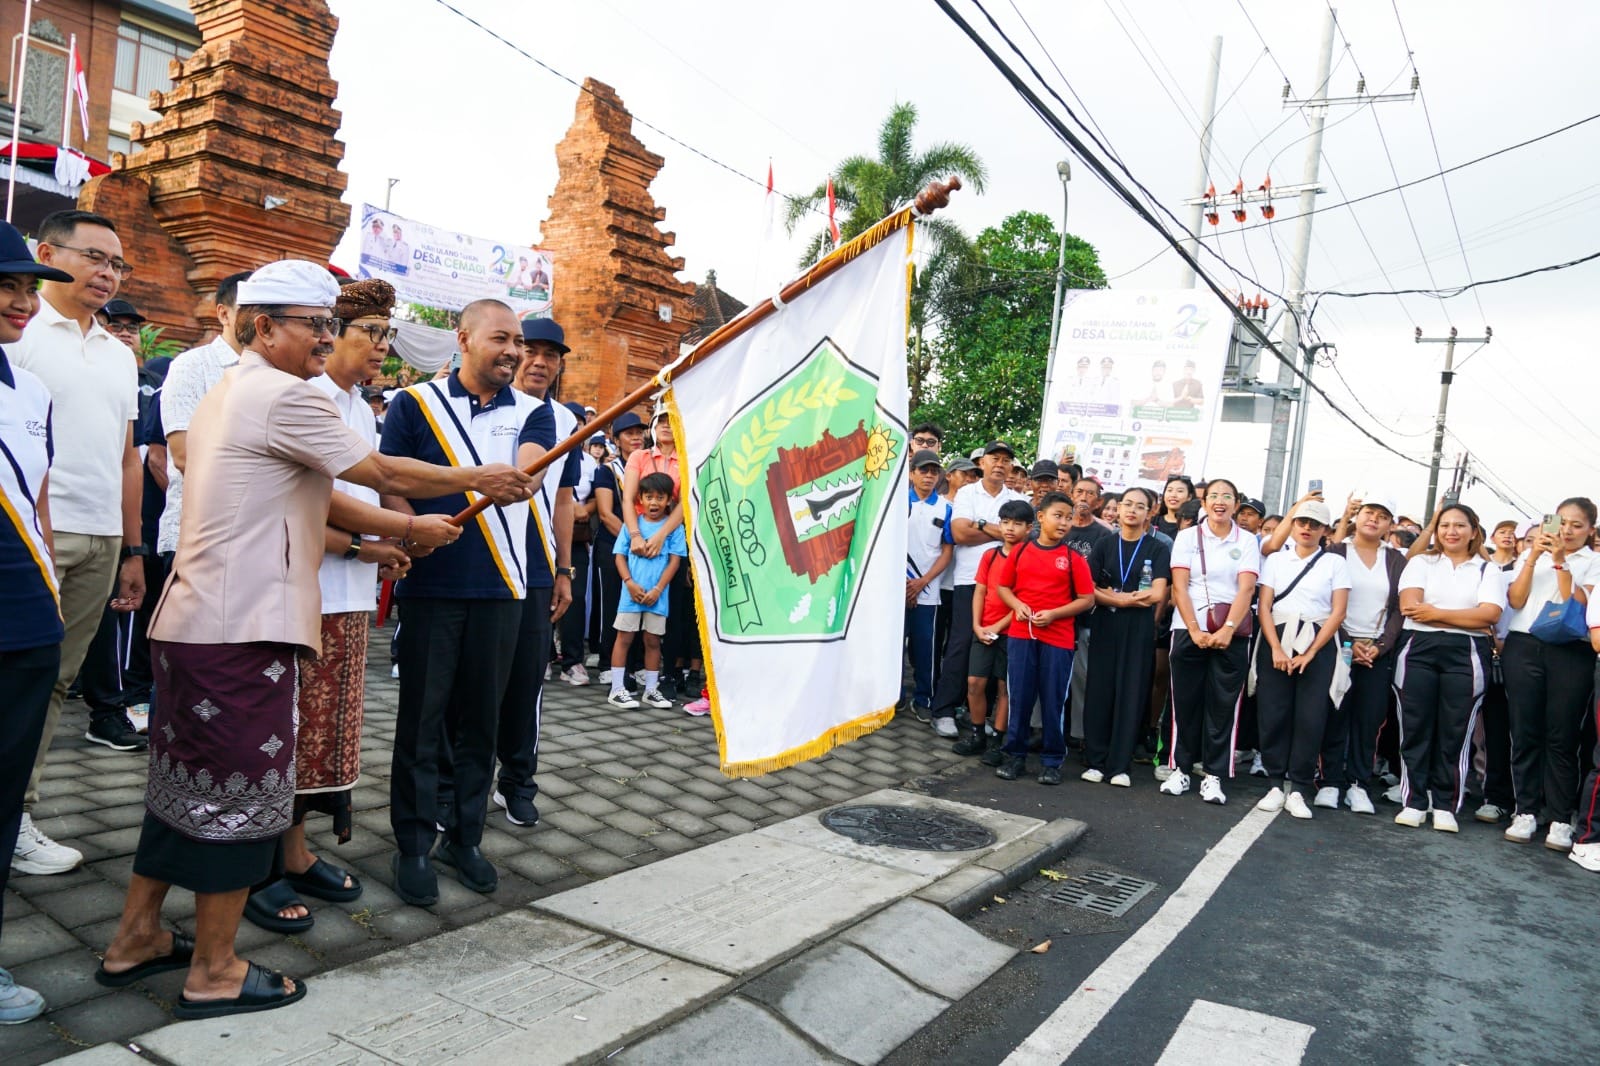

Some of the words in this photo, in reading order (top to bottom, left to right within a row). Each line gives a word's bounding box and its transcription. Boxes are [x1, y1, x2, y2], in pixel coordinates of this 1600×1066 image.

[412, 249, 441, 266] DESA
[443, 257, 486, 276] CEMAGI
[1071, 327, 1106, 340] DESA
[1107, 329, 1163, 342] CEMAGI
[709, 498, 725, 535] DESA
[719, 536, 738, 588] CEMAGI
